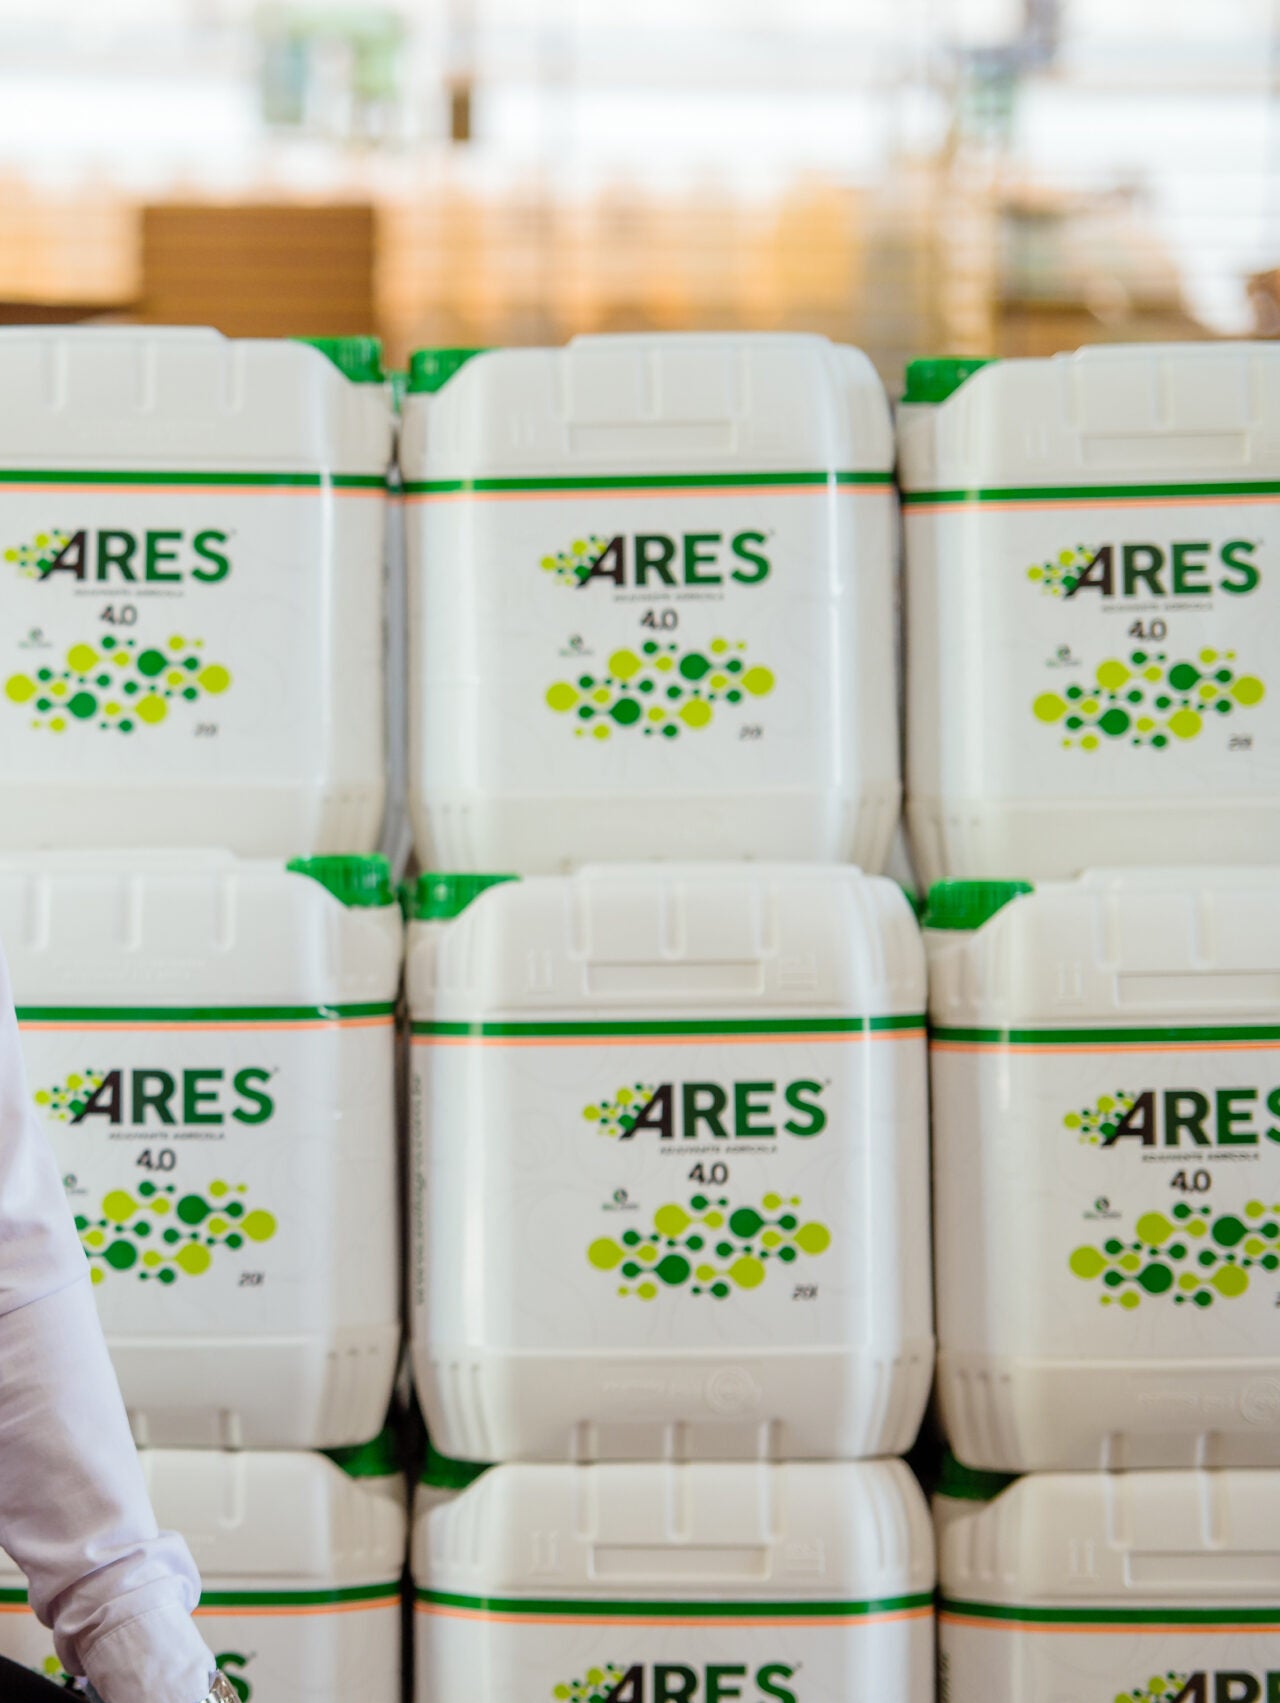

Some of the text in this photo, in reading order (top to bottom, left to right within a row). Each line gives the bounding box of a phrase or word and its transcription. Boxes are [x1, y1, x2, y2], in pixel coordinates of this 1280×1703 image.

[38, 529, 231, 583] ARES
[576, 531, 771, 588] ARES
[1064, 540, 1261, 598] ARES
[100, 604, 138, 626] 4.0
[641, 608, 679, 631] 4.0
[1129, 618, 1168, 642] 4.0
[70, 1067, 275, 1125] ARES
[620, 1079, 828, 1140] ARES
[136, 1147, 177, 1172] 4.0
[688, 1161, 729, 1185] 4.0
[1170, 1168, 1213, 1193] 4.0
